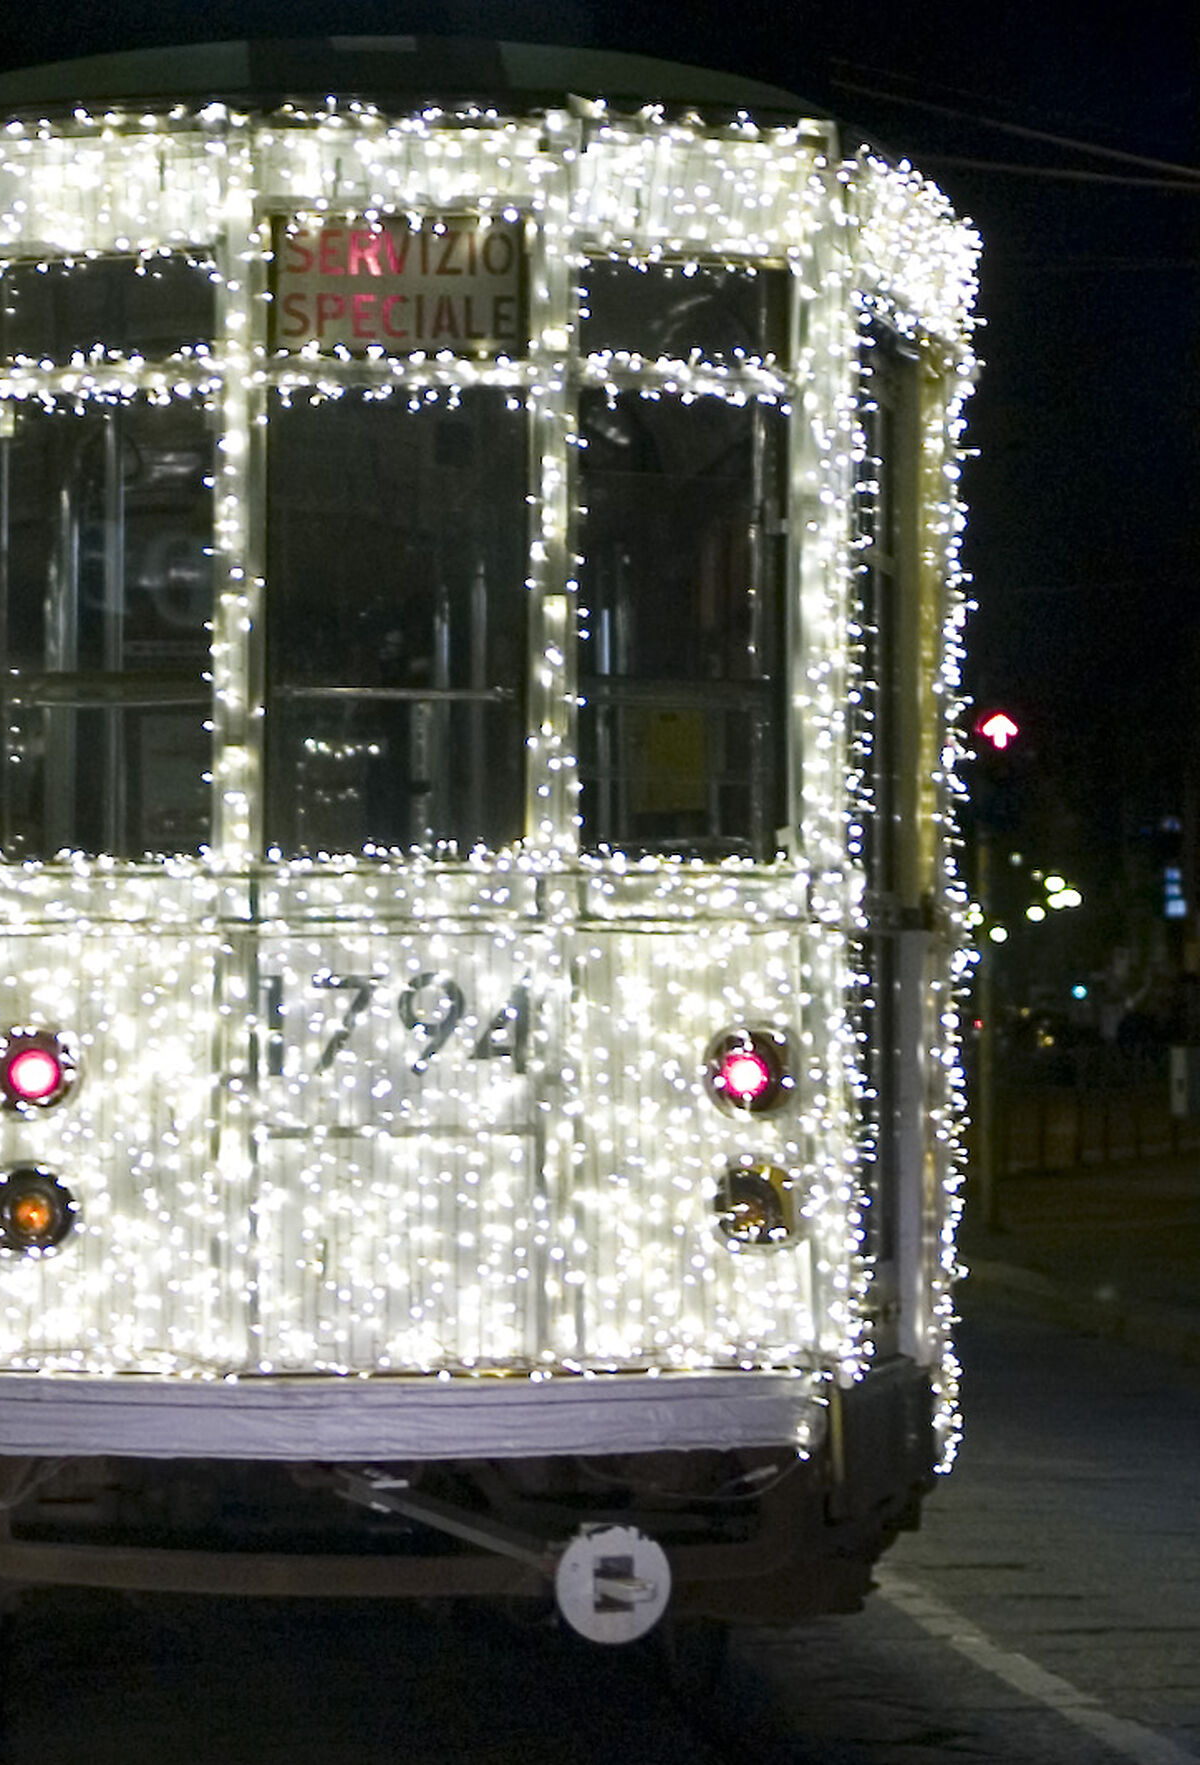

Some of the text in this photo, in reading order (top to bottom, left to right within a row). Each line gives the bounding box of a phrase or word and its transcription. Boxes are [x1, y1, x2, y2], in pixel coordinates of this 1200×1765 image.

[285, 228, 514, 277] SERVIZIO
[281, 292, 517, 339] SPECIALE
[263, 969, 530, 1076] 1794
